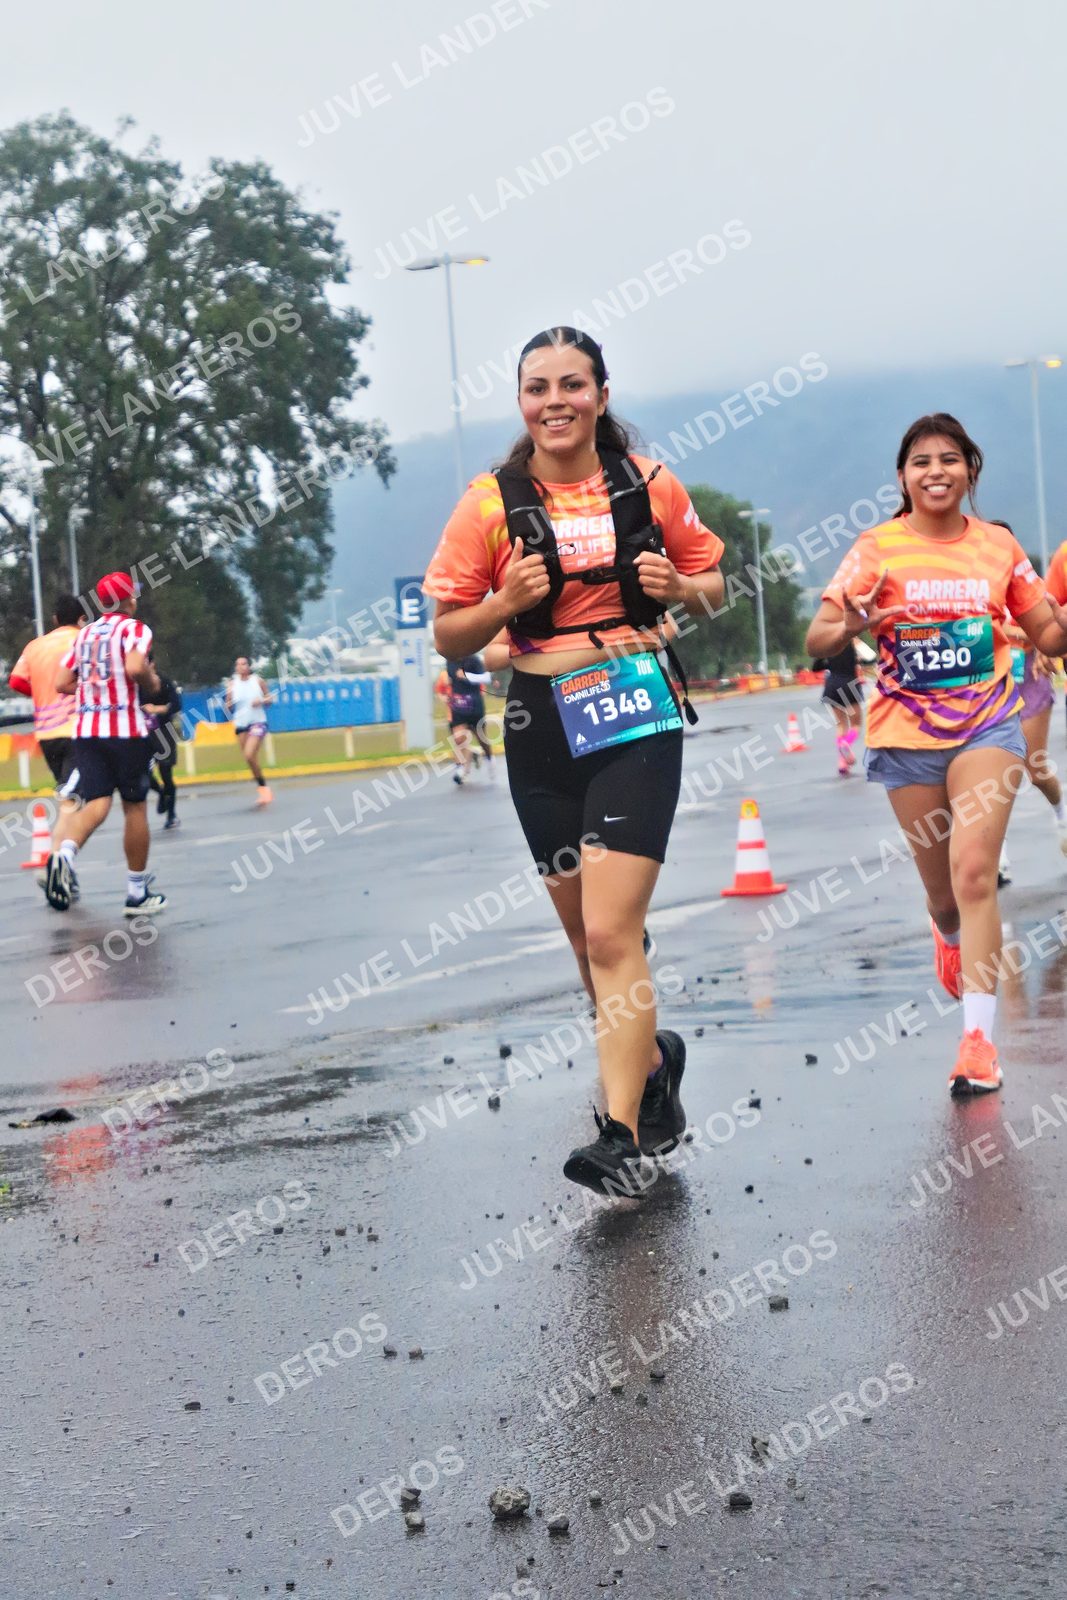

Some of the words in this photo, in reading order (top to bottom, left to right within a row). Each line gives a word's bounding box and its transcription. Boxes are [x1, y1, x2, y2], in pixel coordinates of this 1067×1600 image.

[905, 579, 989, 601] CARRERA
[402, 598, 420, 624] E
[900, 628, 941, 640] CARRERA
[967, 621, 984, 636] 10K
[635, 659, 654, 676] 10K
[913, 647, 972, 671] 1290
[561, 669, 609, 696] CARRERA
[564, 684, 601, 704] OMNILIFE
[583, 688, 652, 726] 1348
